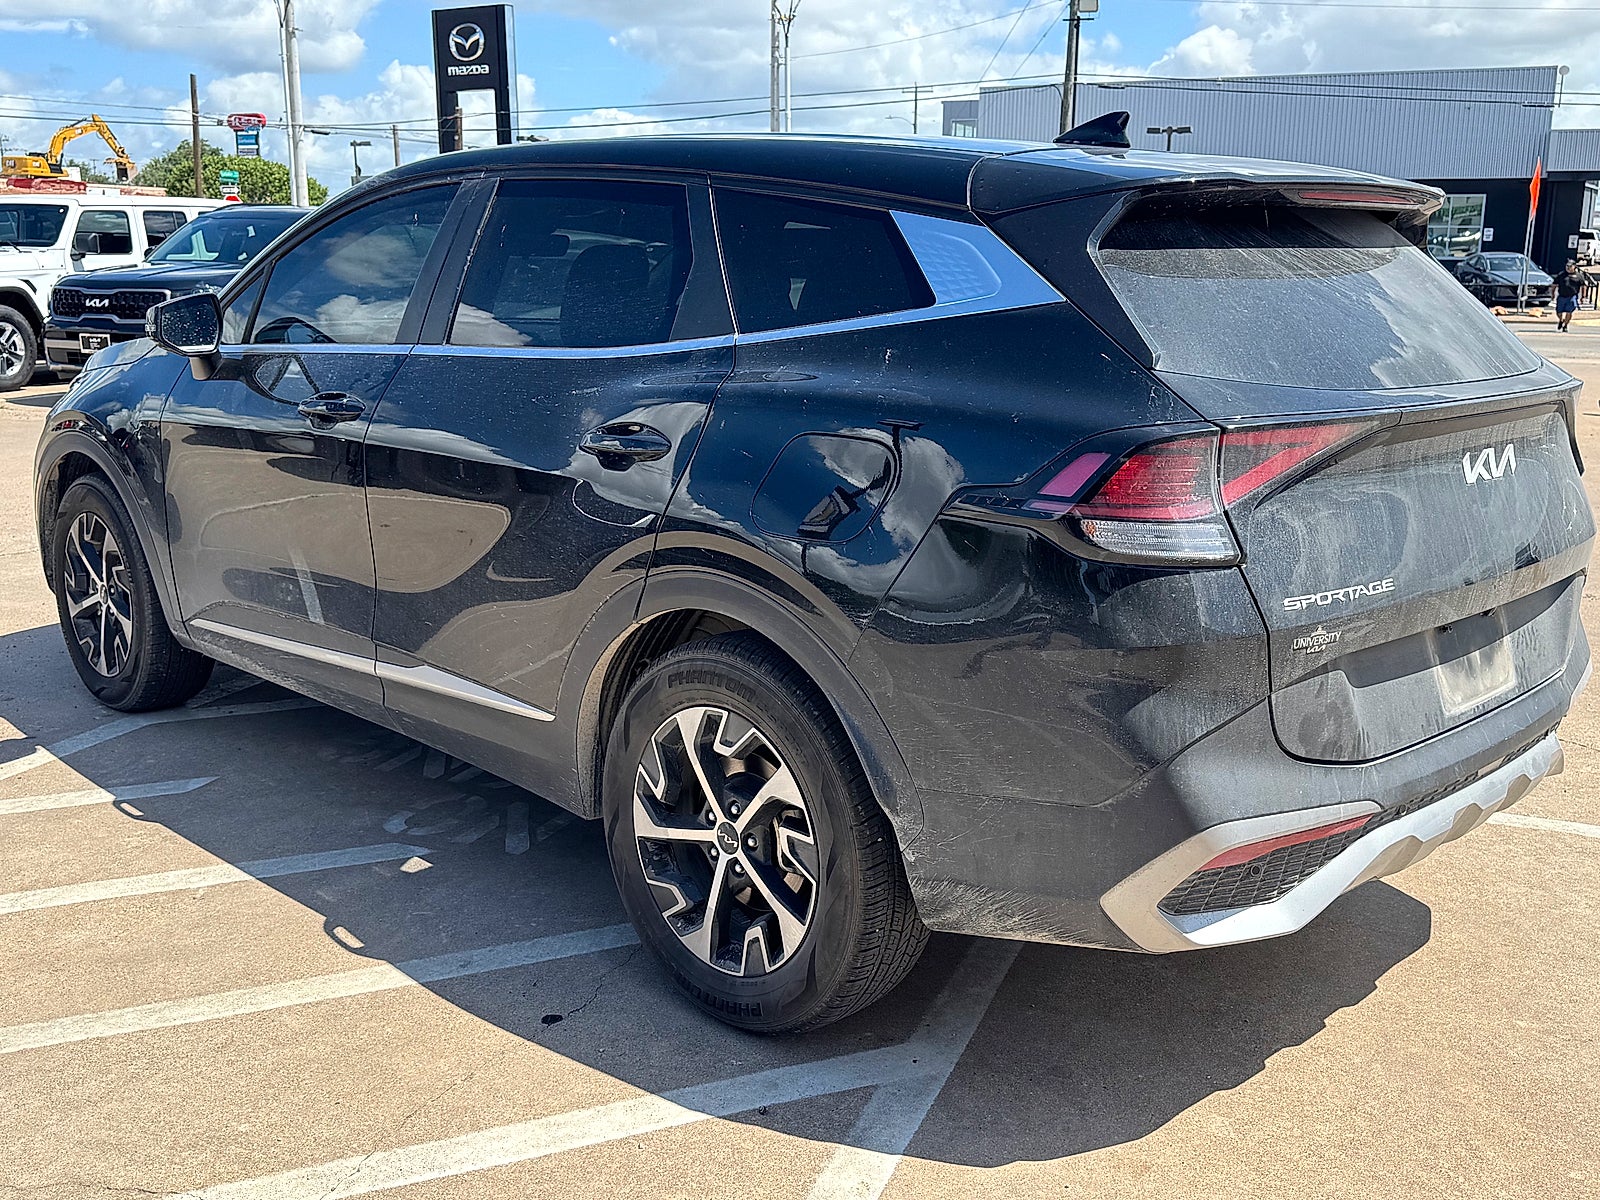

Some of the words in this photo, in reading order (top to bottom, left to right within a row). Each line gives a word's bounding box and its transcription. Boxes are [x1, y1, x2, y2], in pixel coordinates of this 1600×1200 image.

[447, 64, 490, 76] mazda
[85, 298, 109, 308] KIA
[1462, 443, 1517, 485] KIA
[1282, 578, 1396, 612] SPORTAGE
[1292, 630, 1343, 650] UNIVERSITY
[1306, 644, 1327, 654] KIA
[667, 668, 757, 703] PHANTOM
